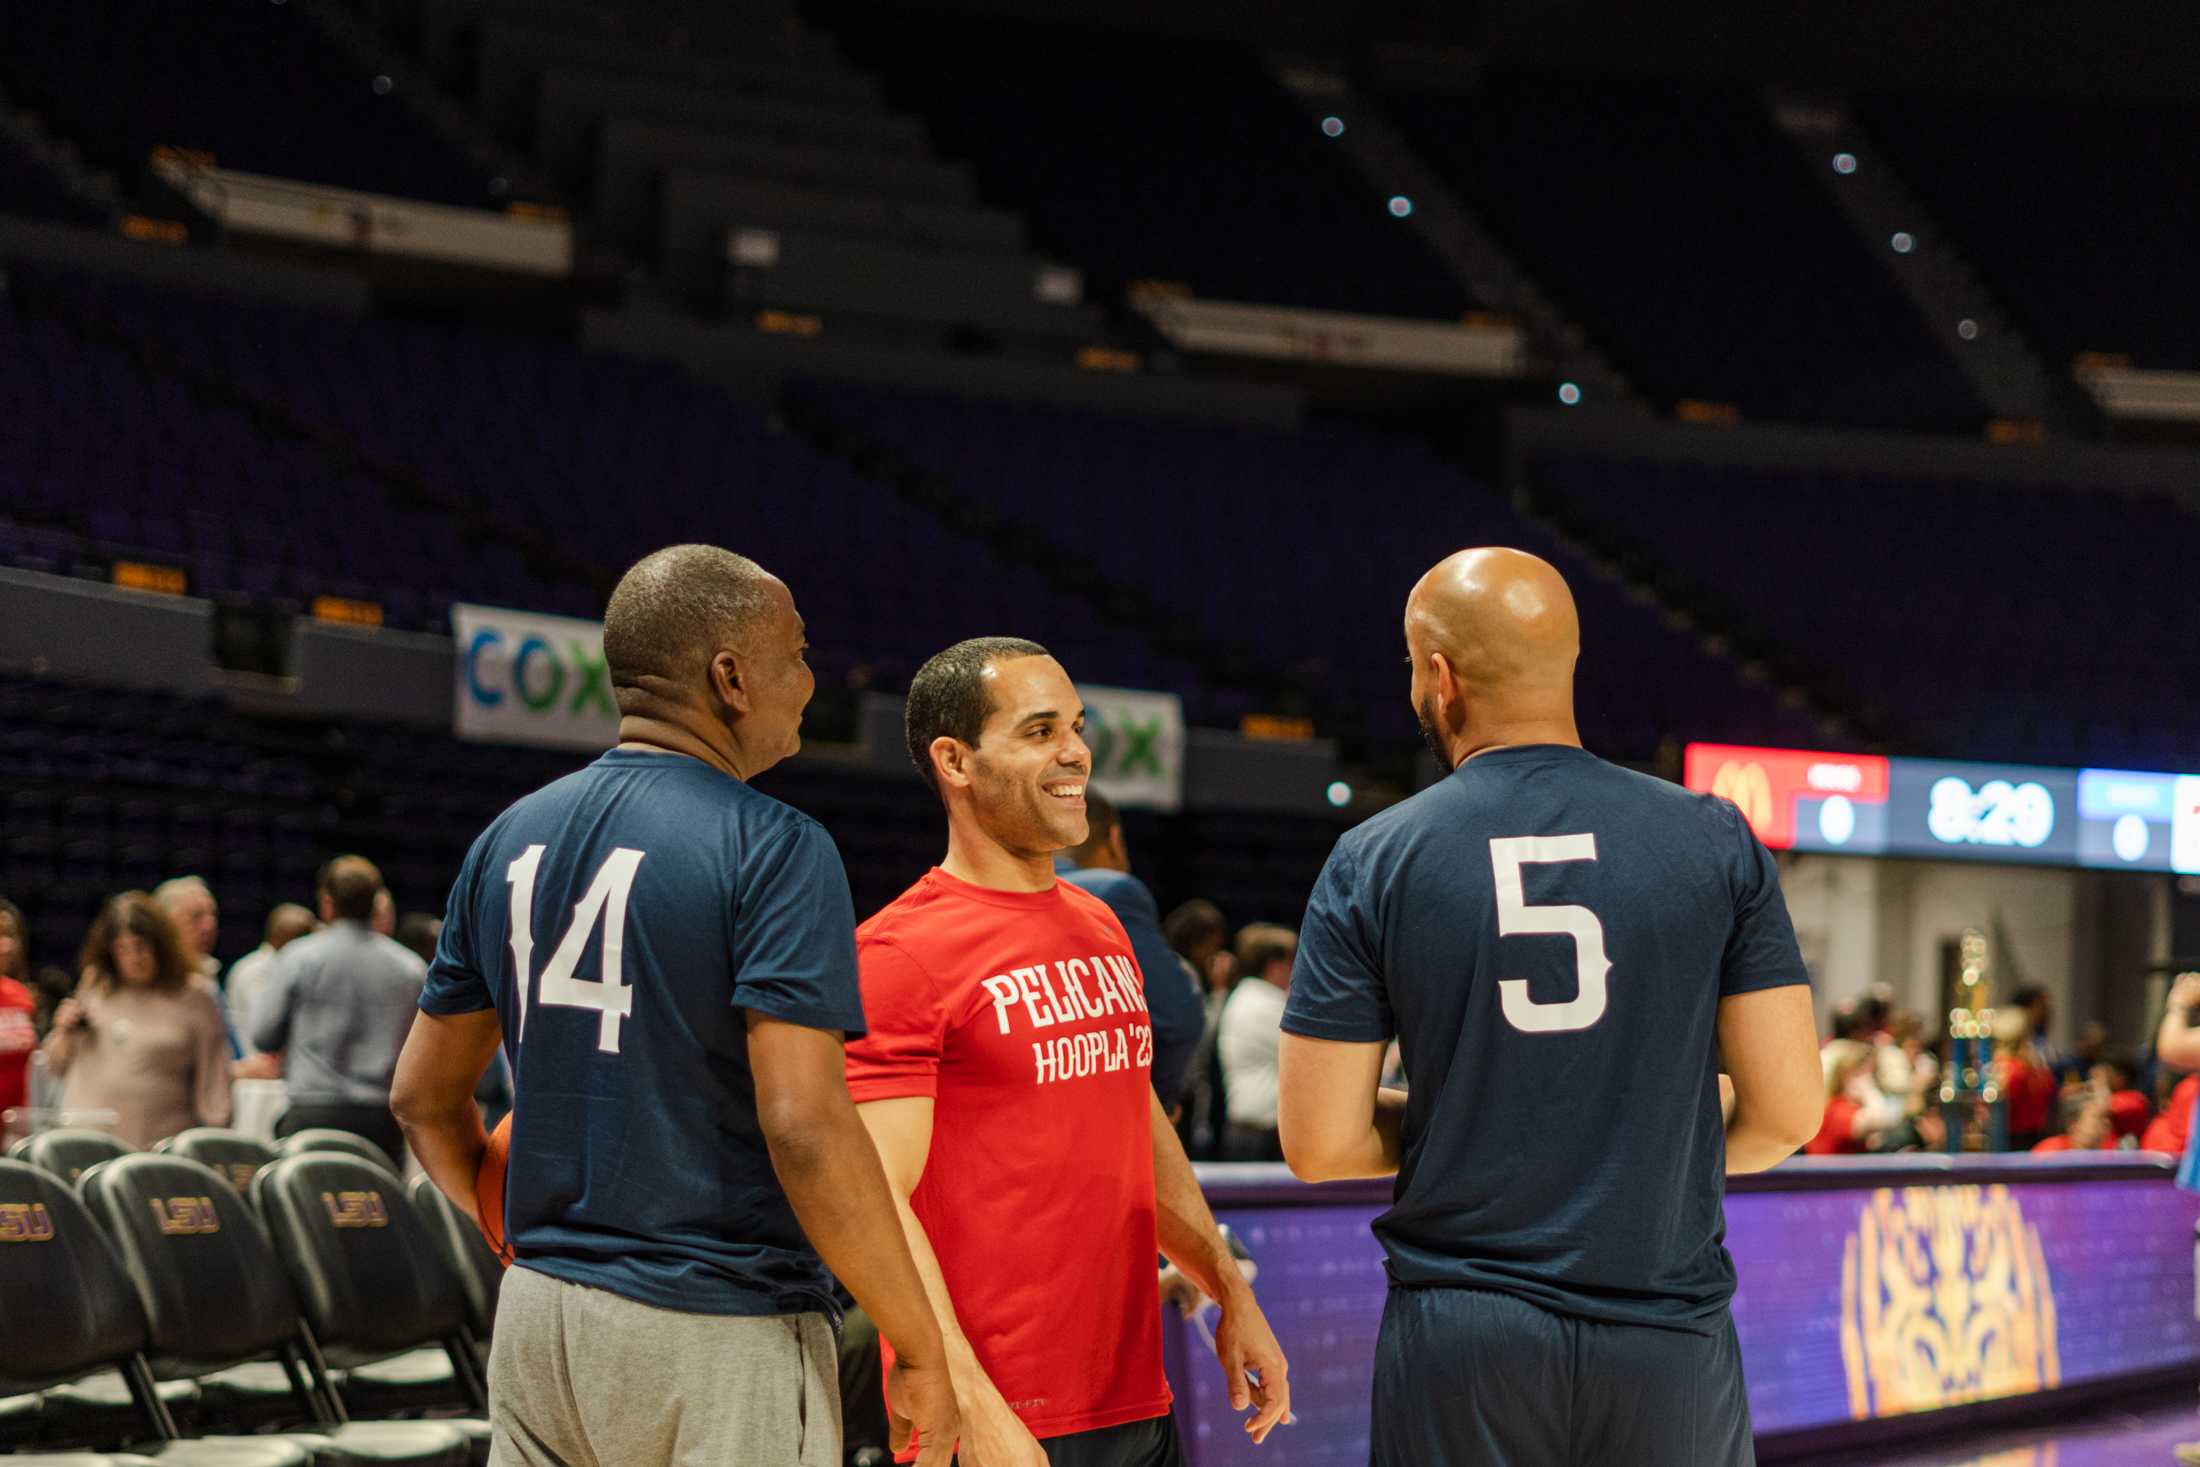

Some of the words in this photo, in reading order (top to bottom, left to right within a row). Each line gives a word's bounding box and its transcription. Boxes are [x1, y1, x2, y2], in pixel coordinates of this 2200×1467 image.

[465, 626, 618, 718] COX
[506, 844, 646, 1053] 14
[1489, 832, 1613, 1032] 5
[981, 955, 1149, 1034] PELICAN
[1032, 1027, 1130, 1084] HOOPLA
[150, 1197, 220, 1235] LSU
[321, 1191, 389, 1228] LSU
